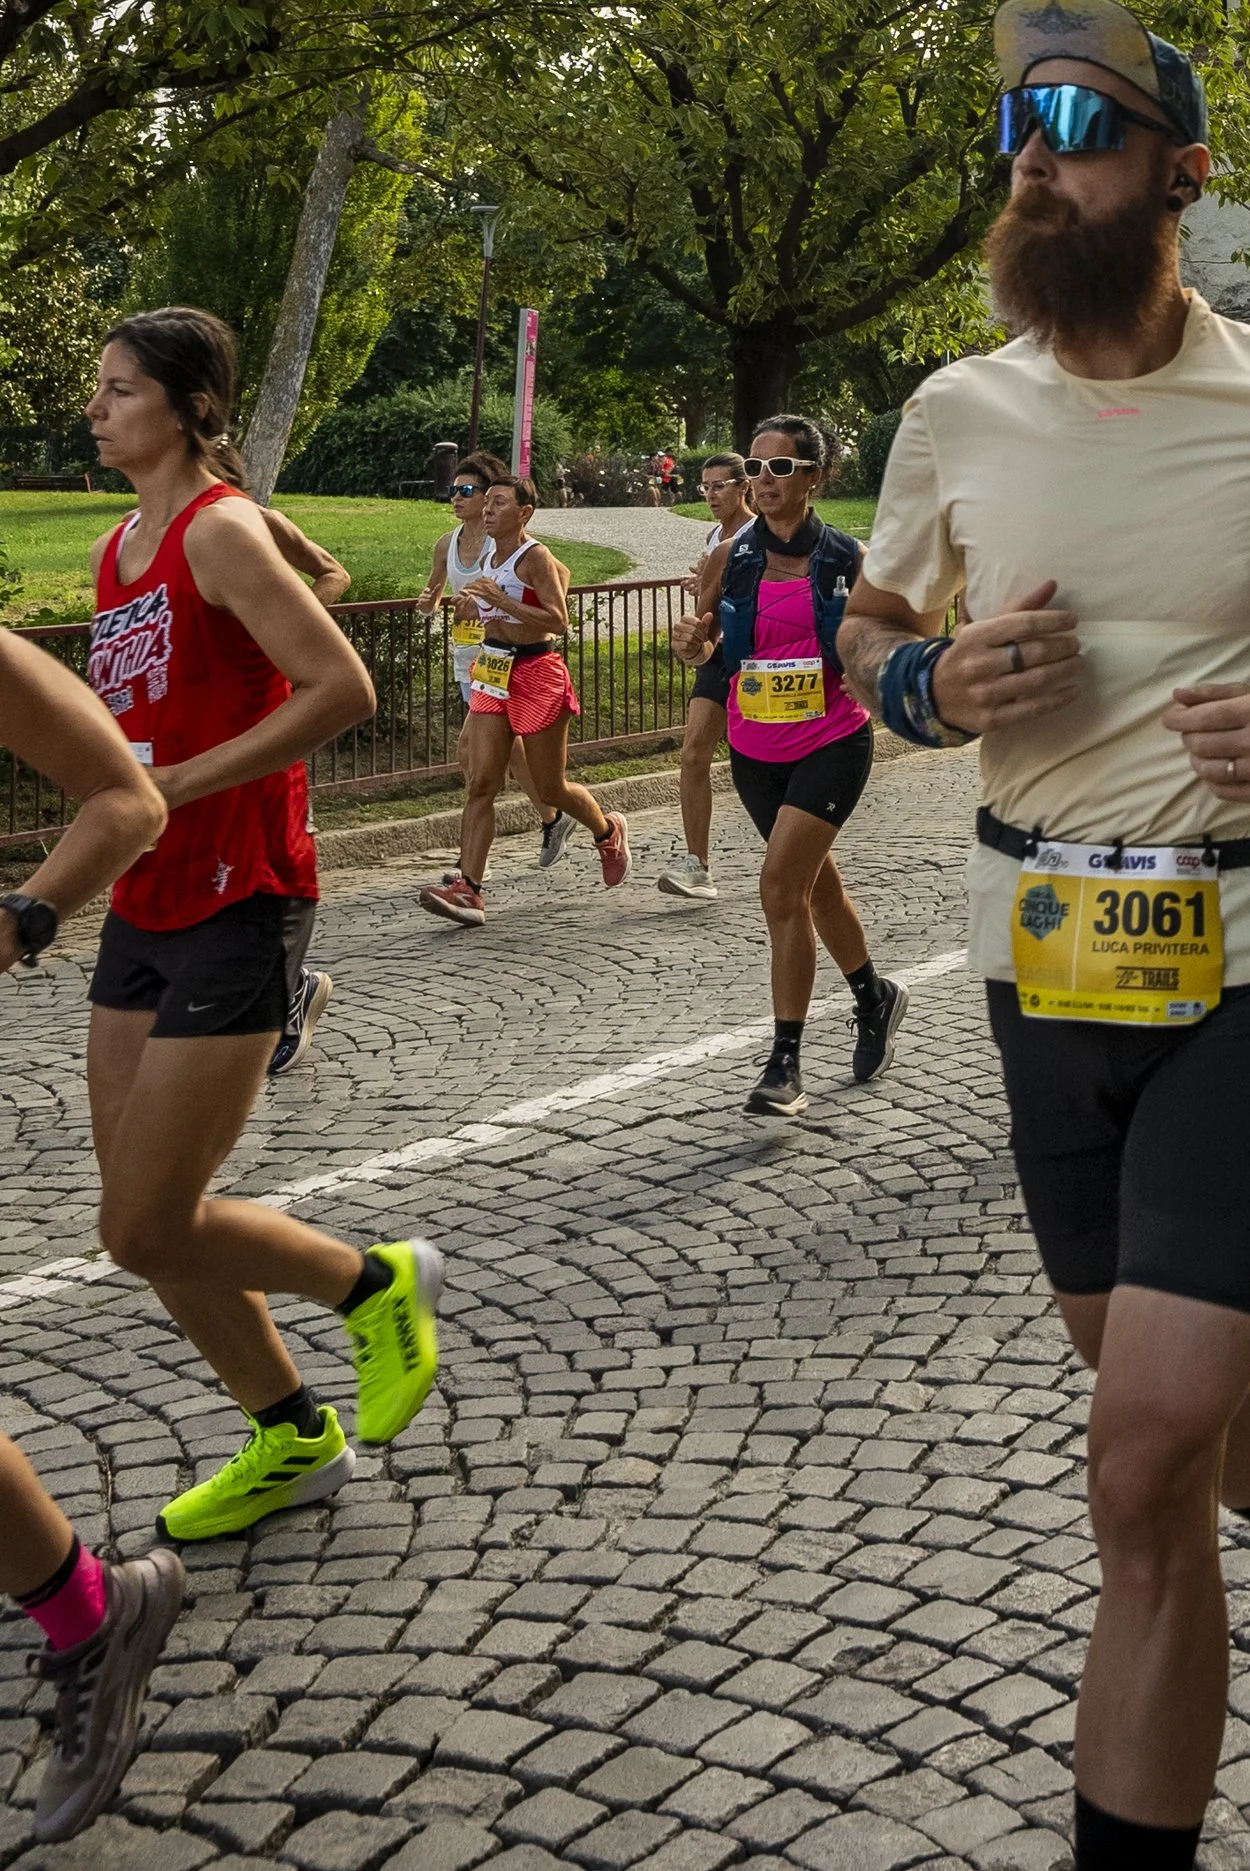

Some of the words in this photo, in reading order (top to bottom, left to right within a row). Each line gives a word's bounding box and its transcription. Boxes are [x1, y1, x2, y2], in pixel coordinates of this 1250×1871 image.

[771, 673, 818, 693] 3277
[1019, 897, 1070, 917] CINQUE
[1093, 889, 1205, 938] 3061
[1021, 912, 1062, 931] LAGHI
[1092, 941, 1128, 954] LUCA
[1133, 941, 1210, 956] PRIVITERA
